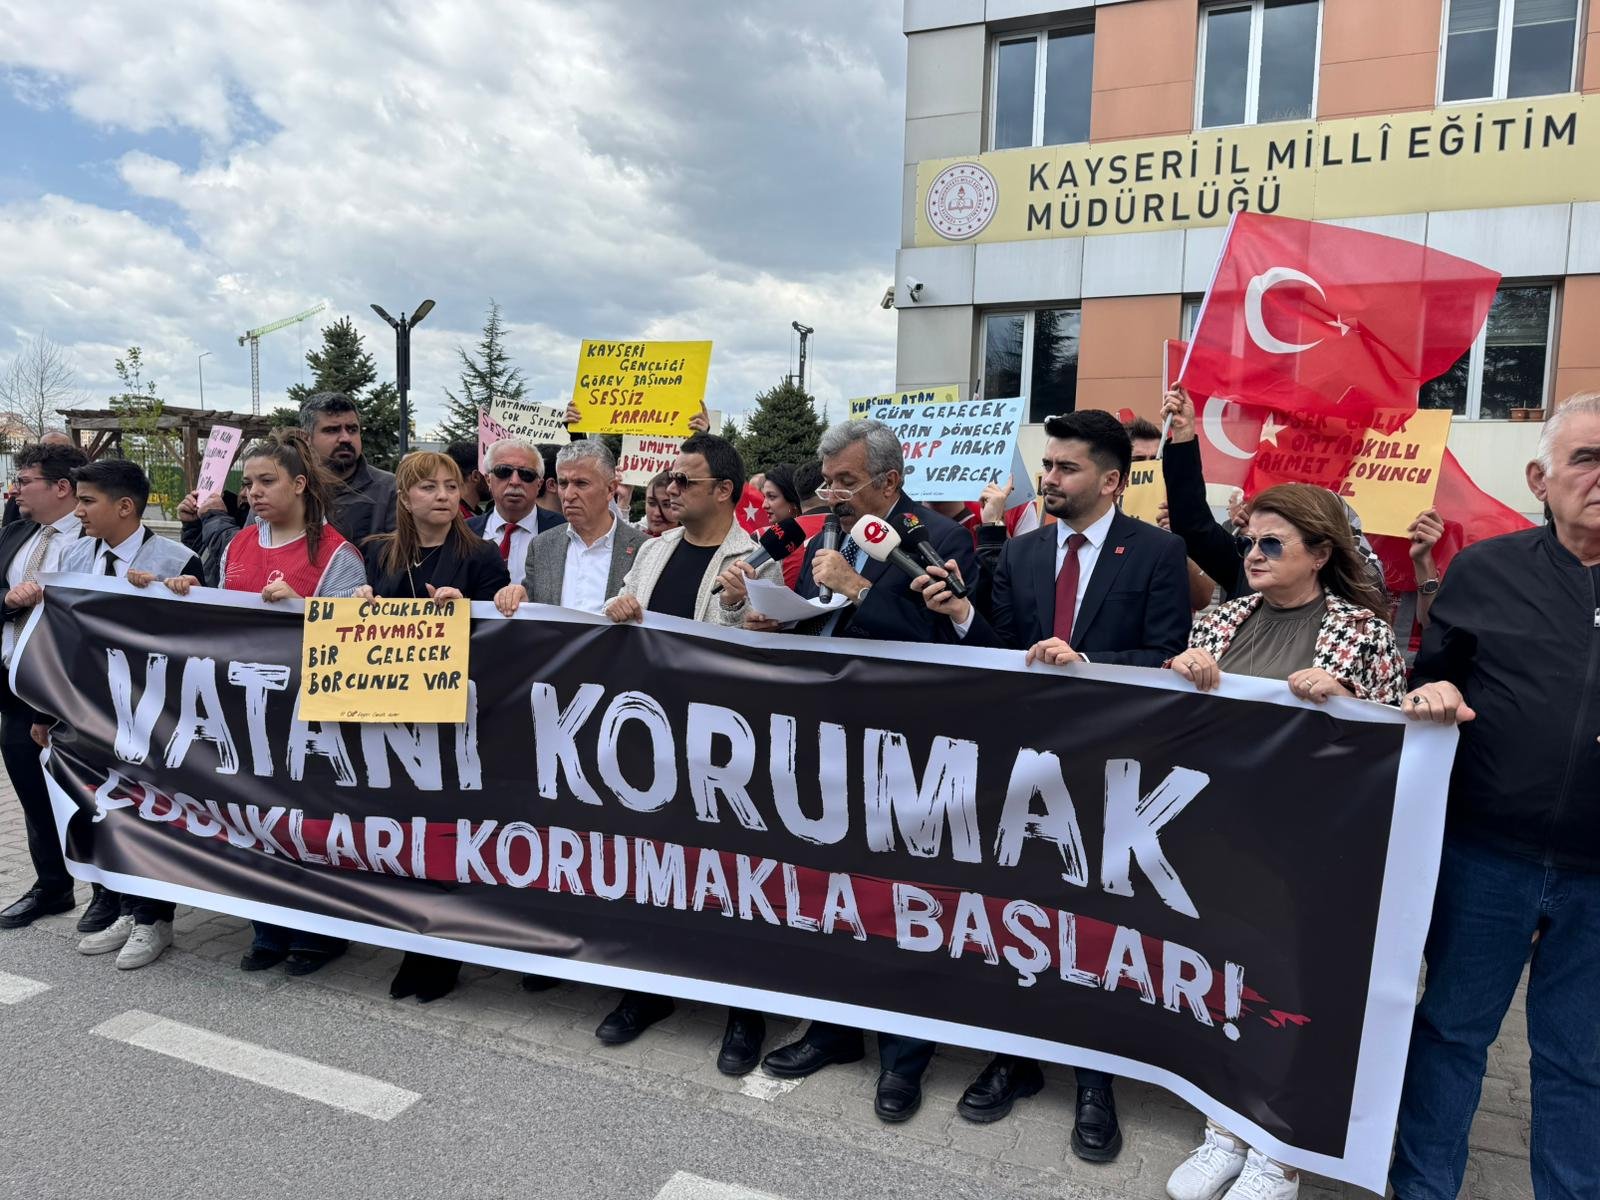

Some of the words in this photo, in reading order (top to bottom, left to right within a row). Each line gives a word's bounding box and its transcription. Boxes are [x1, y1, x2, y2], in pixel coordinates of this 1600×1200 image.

[1029, 140, 1197, 192] KAYSERİ
[1215, 137, 1250, 175] İL
[1267, 122, 1392, 171] MİLLÎ
[1408, 108, 1577, 159] EĞİTİM
[1027, 176, 1281, 232] MÜDÜRLÜĞÜ
[587, 344, 645, 358] KAYSERİ
[580, 374, 625, 388] GÖREV
[633, 373, 683, 388] BAŞINDA
[588, 388, 644, 406] SESSİZ
[901, 392, 935, 405] ATAN
[495, 399, 540, 413] VATANINI
[550, 409, 564, 418] EN
[610, 409, 680, 426] KARARLI!
[875, 406, 914, 420] GÜN
[922, 402, 1007, 418] GELECEK
[530, 414, 563, 429] SEVEN
[940, 421, 1015, 438] DÖNECEK
[639, 440, 680, 455] UMUTL
[951, 439, 1005, 456] HALKA
[1292, 434, 1420, 460] ORTAOKULU
[926, 464, 1003, 484] VERECEK
[1257, 452, 1330, 474] AHMET
[1339, 462, 1431, 484] KOYUNCU
[307, 600, 335, 622] BU
[336, 620, 445, 642] TRAVMASIZ
[308, 644, 339, 668] BİR
[367, 645, 451, 665] GELECEK
[307, 671, 409, 695] BORCUNUZ
[423, 671, 461, 691] VAR
[530, 682, 1211, 918] KORUMAK
[454, 818, 868, 941] KORUMAKLA
[892, 882, 1245, 1041] BAŞLAR!
